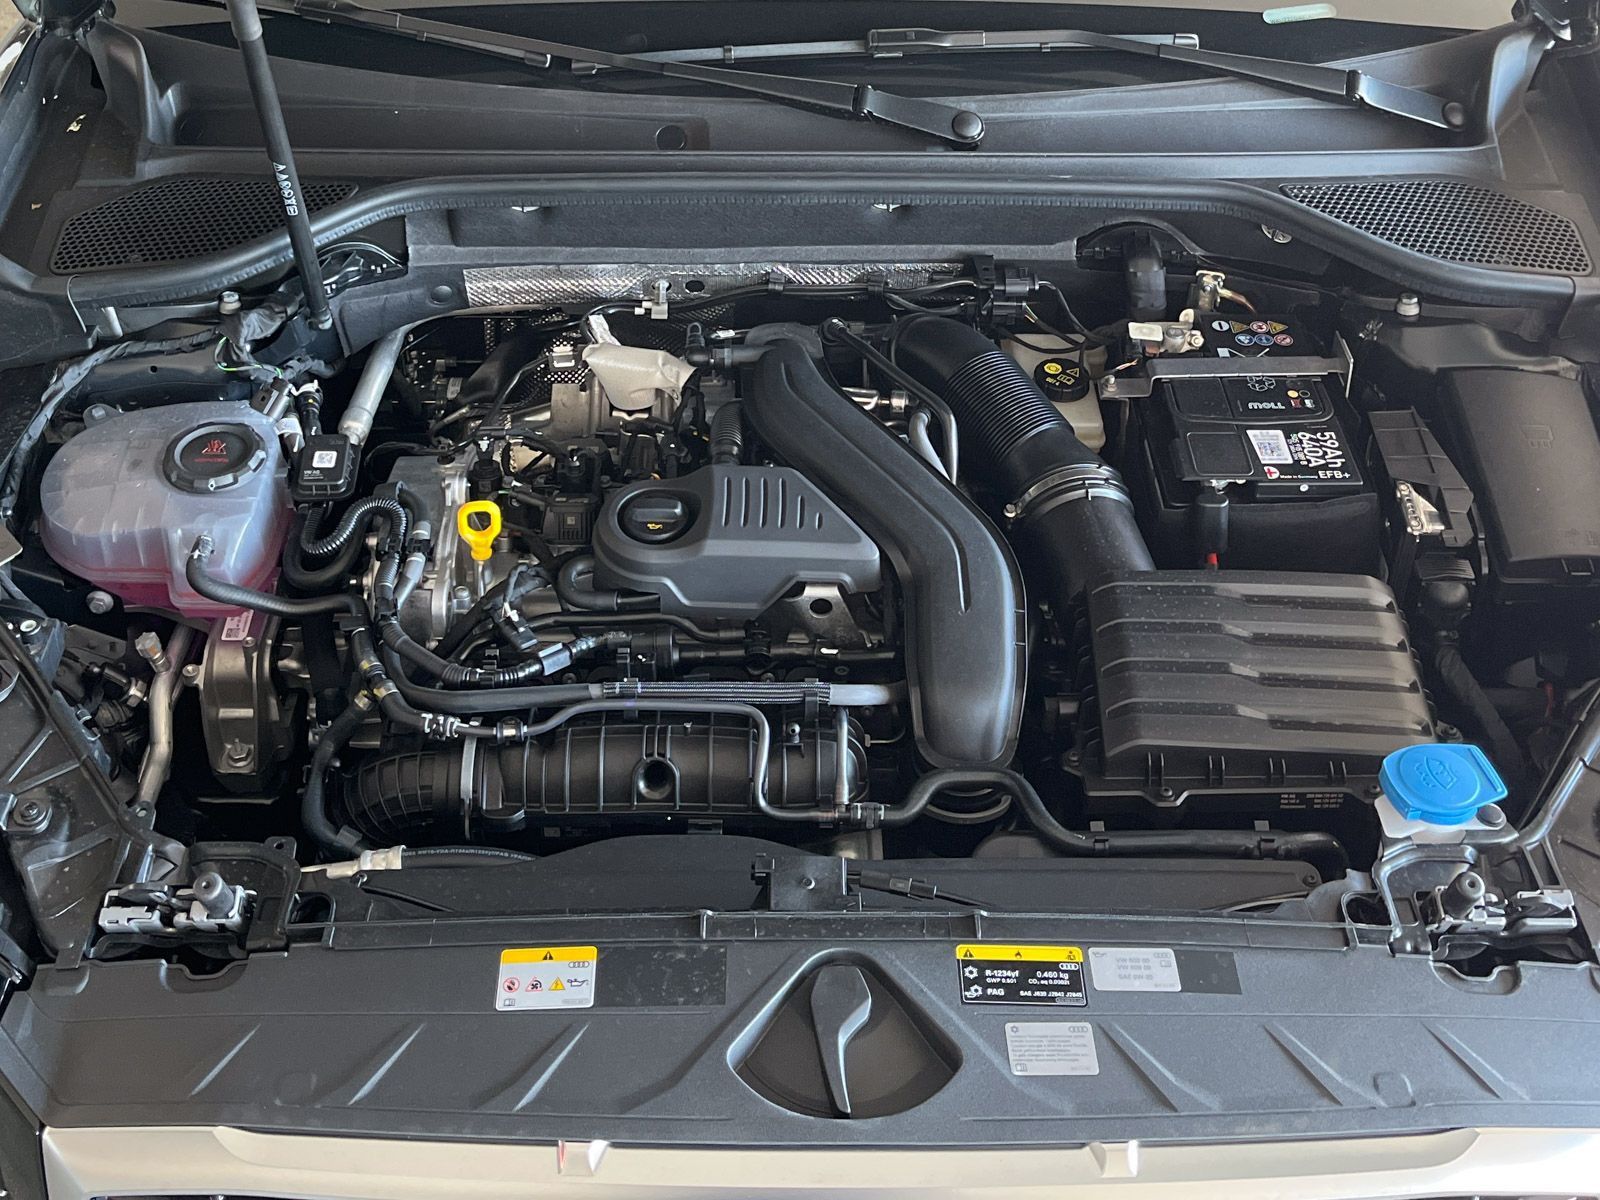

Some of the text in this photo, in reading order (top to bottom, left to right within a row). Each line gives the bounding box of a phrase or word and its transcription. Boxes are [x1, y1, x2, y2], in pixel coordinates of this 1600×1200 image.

[1297, 431, 1327, 468] 640A
[1316, 431, 1346, 468] 59Ah
[1317, 470, 1350, 479] EFB+
[985, 969, 1020, 978] R-1234yf
[1059, 971, 1069, 980] kg
[987, 988, 1005, 996] PAG
